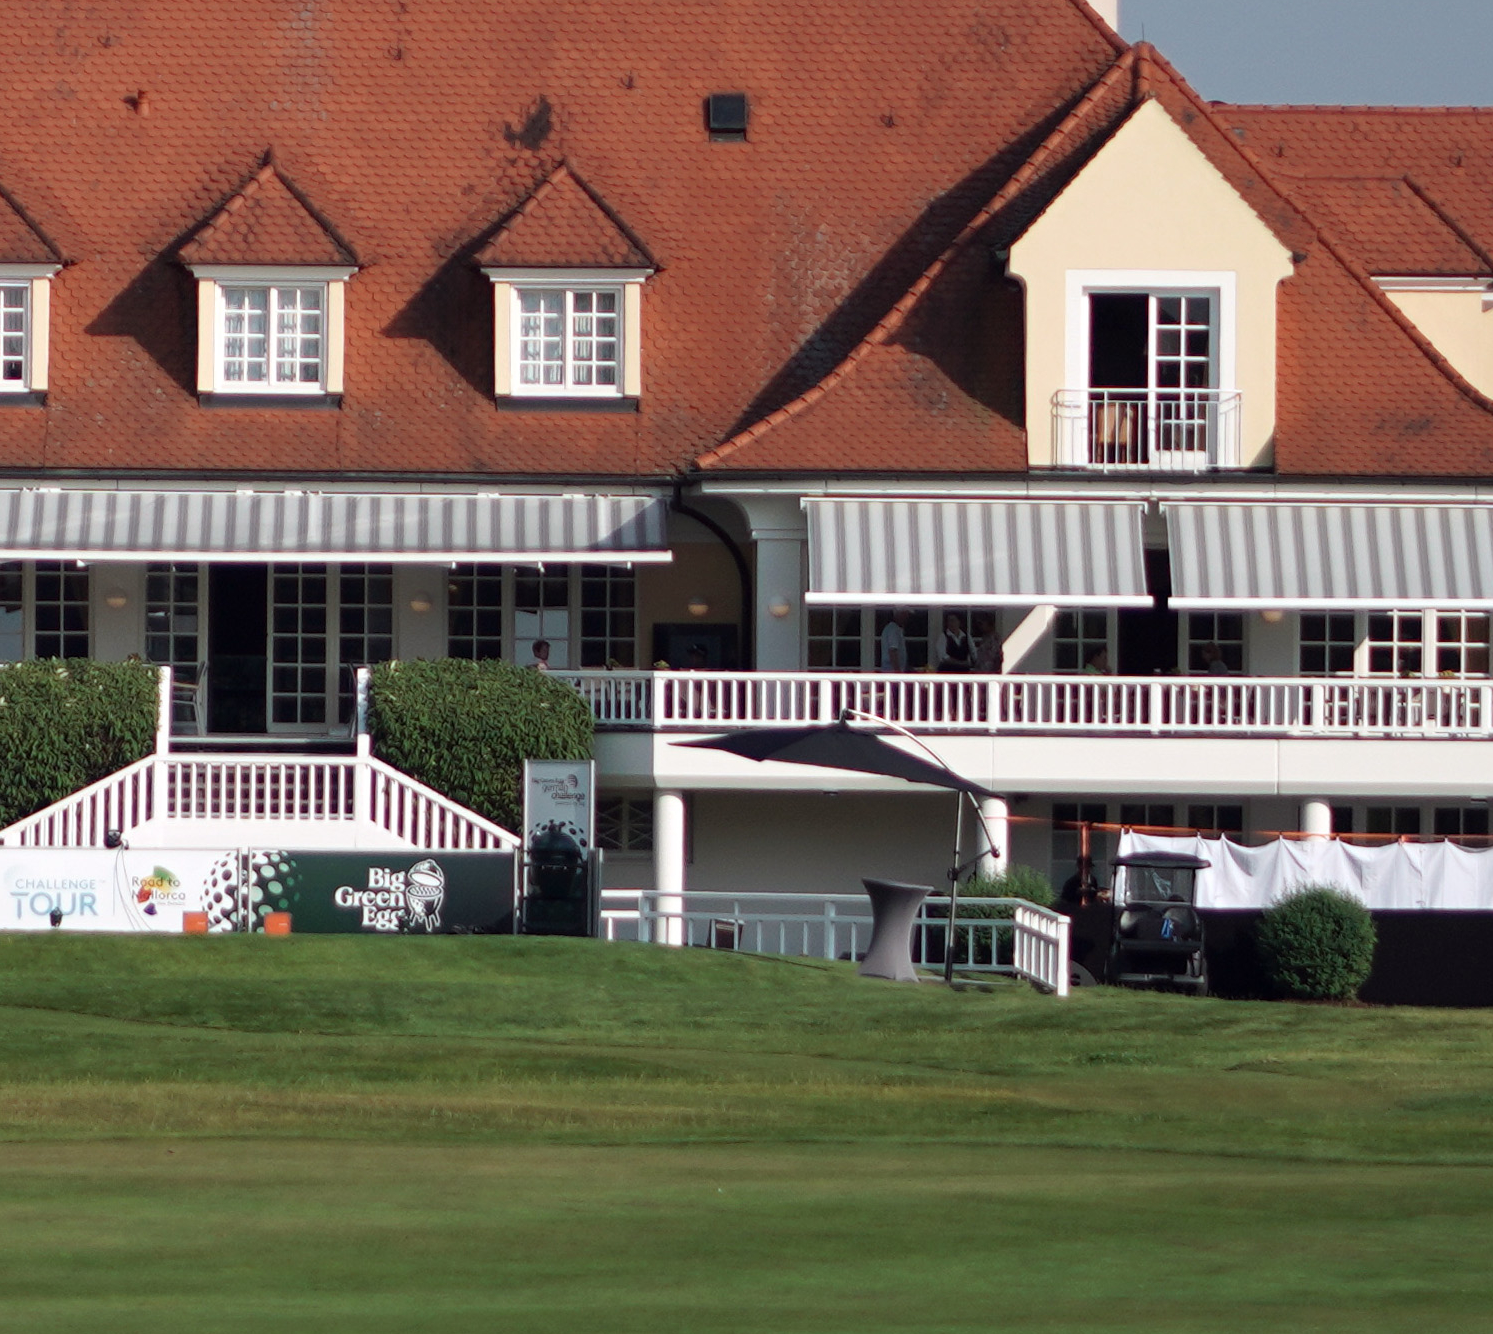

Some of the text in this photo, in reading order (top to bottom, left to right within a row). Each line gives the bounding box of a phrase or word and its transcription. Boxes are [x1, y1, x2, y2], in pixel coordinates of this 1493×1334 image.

[15, 878, 96, 890] CHALLENGE
[131, 875, 181, 887] Road to
[368, 867, 406, 892] Big
[9, 891, 100, 918] TOUR
[335, 885, 406, 907] Green
[361, 905, 406, 931] Egg
